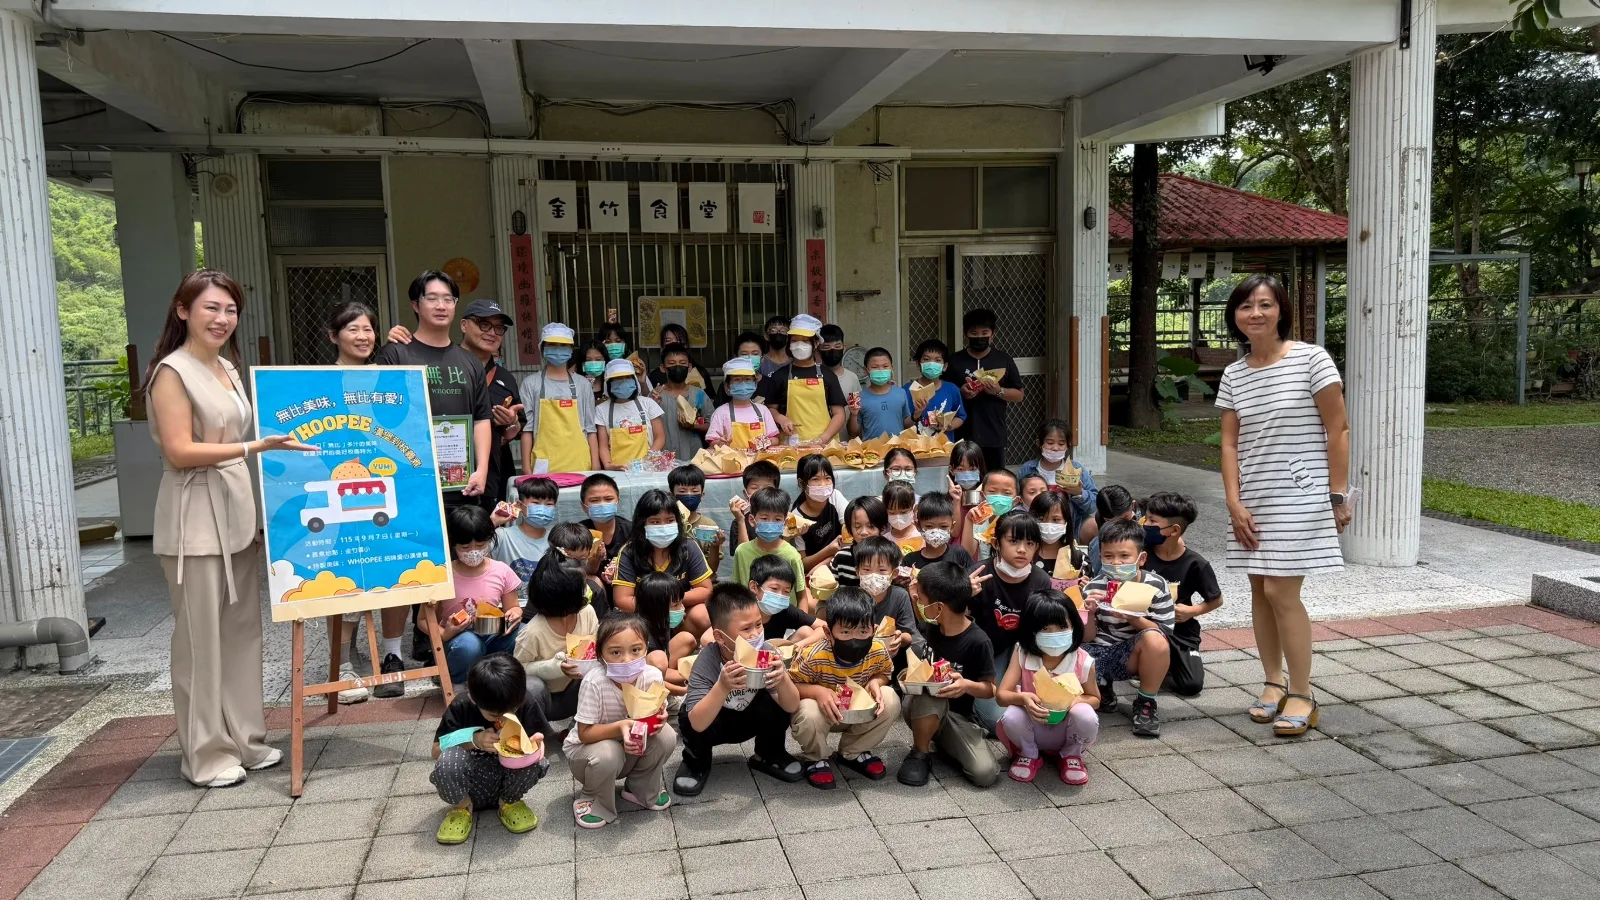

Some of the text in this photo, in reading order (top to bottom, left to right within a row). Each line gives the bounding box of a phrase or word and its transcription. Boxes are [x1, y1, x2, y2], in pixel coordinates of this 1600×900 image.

[548, 196, 718, 219] 金竹食堂
[347, 556, 382, 565] WHOOPEE
